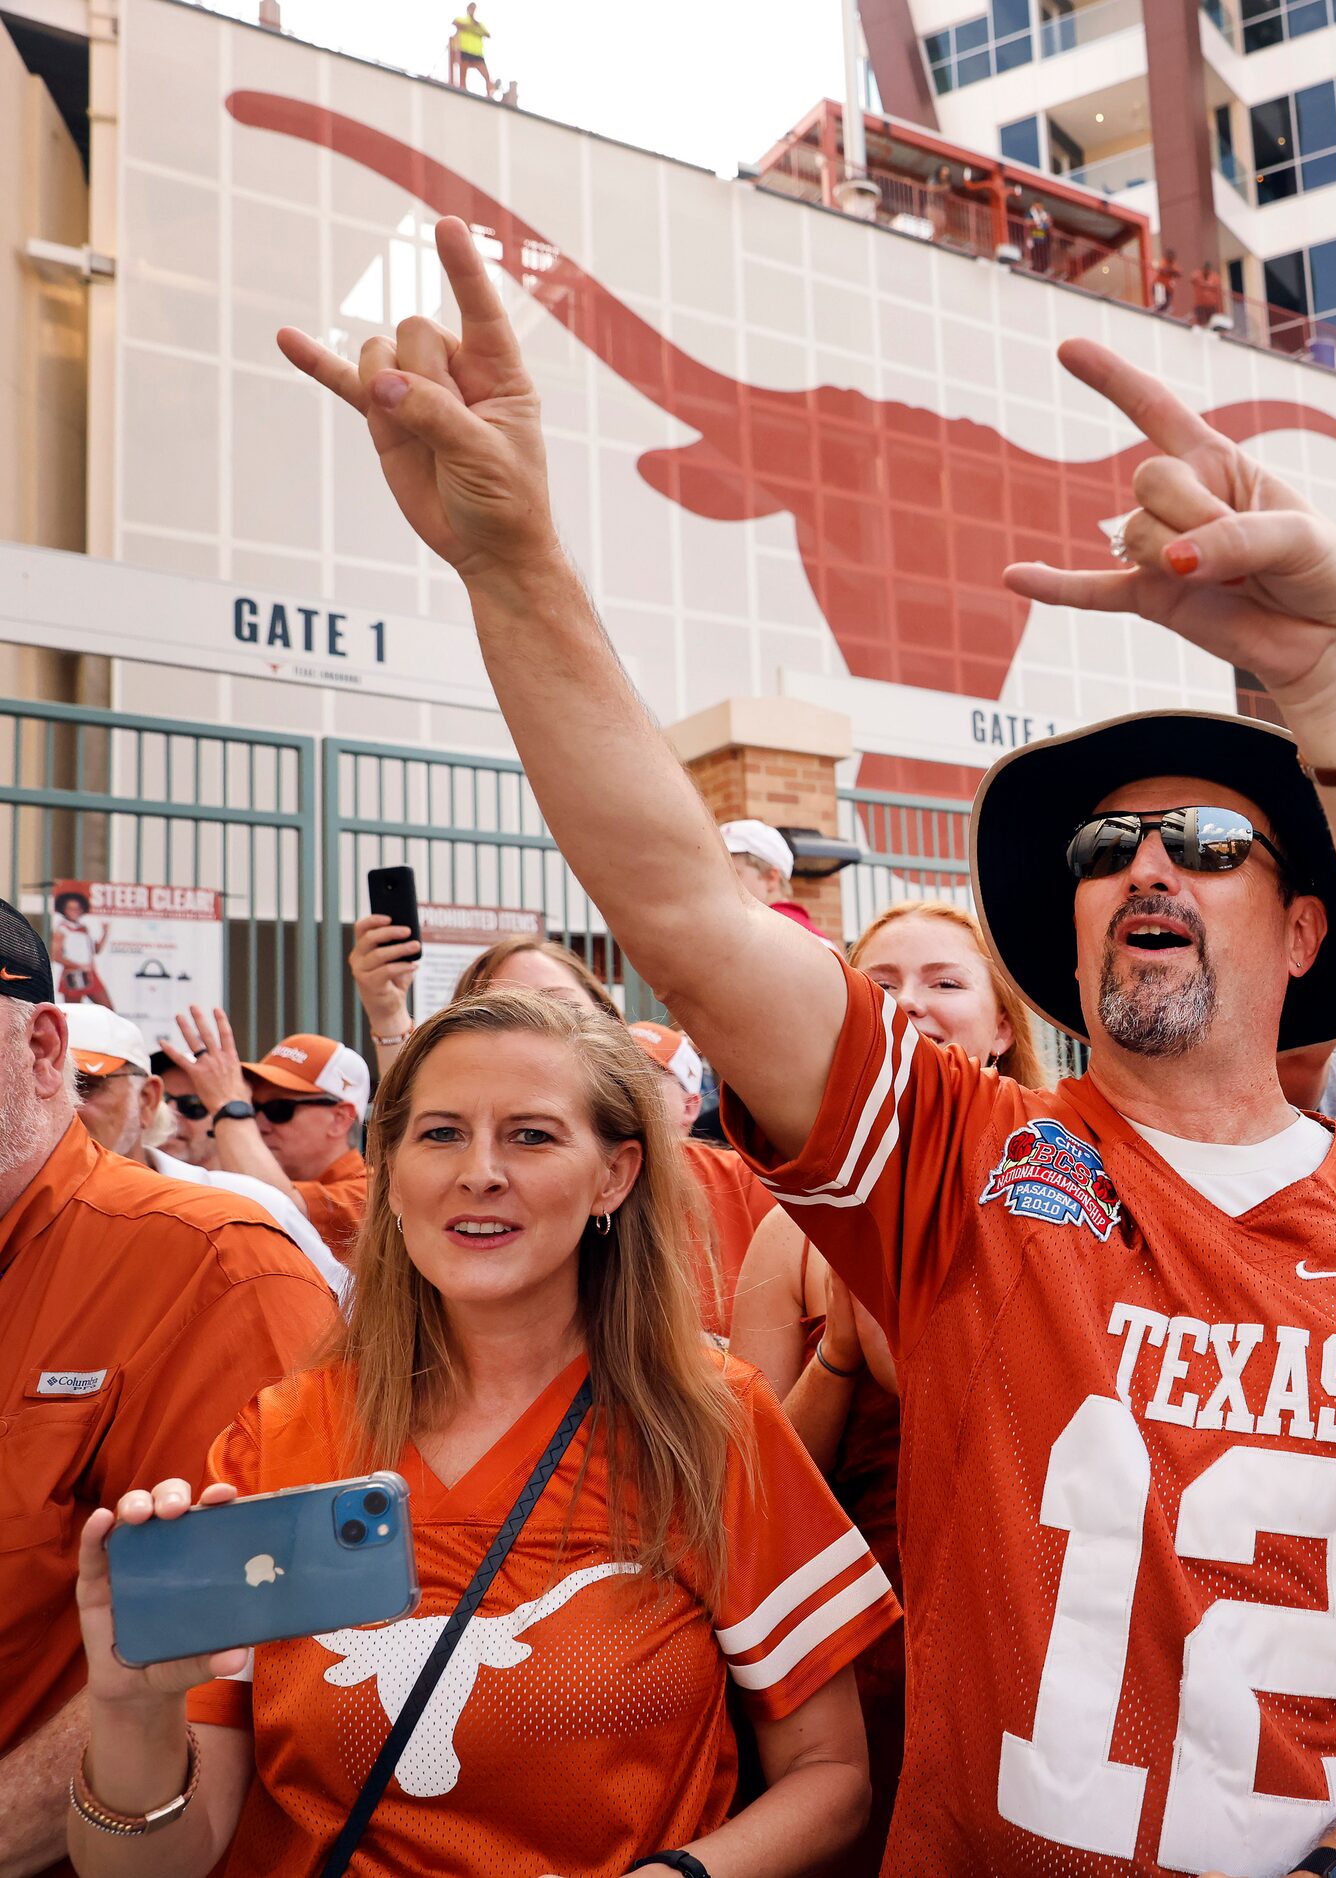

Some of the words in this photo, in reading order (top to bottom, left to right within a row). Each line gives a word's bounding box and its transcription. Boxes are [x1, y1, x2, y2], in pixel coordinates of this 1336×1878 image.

[233, 597, 347, 657] GATE
[370, 620, 386, 663] 1
[971, 709, 1033, 747] GATE
[90, 882, 149, 910] STEER
[1029, 1141, 1093, 1186] BCS
[996, 1164, 1041, 1190] NATIONAL
[1040, 1168, 1107, 1227] CHAMPIONSHIP
[1015, 1184, 1077, 1212] PASADENA
[1020, 1196, 1061, 1216] 2010
